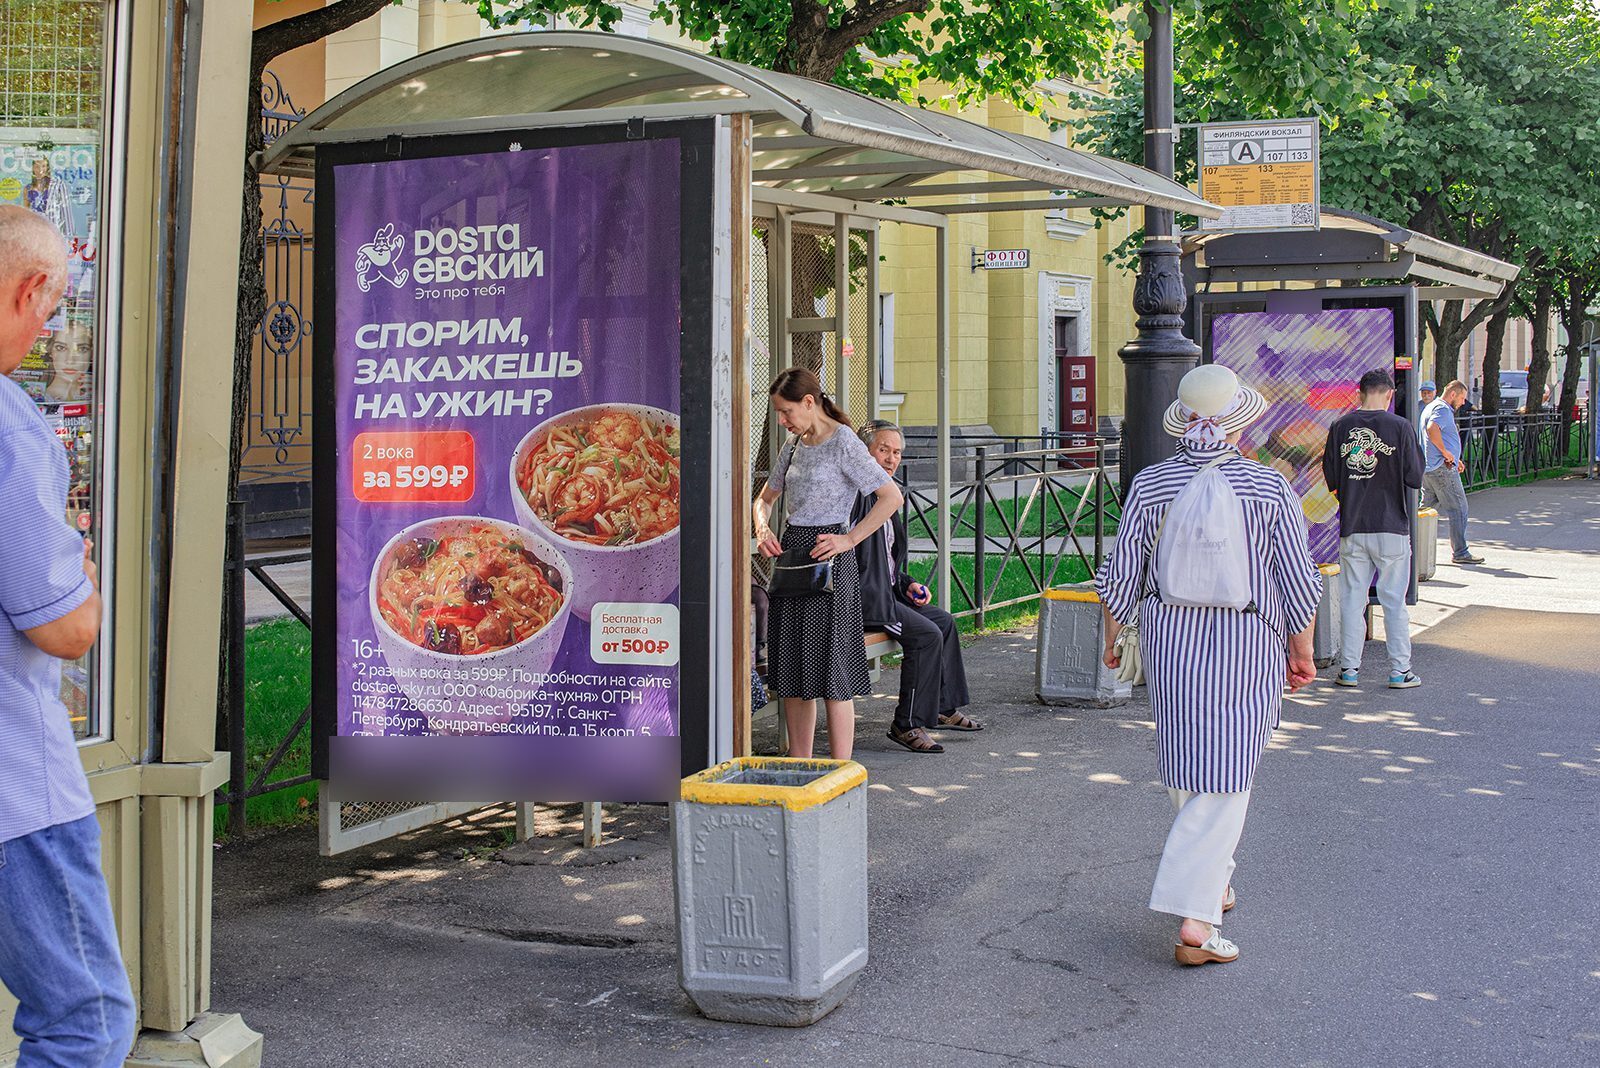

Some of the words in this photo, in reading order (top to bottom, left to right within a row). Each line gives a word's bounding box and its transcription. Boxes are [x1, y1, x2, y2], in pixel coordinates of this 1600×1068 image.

[1213, 129, 1270, 139] ФИНЛЯНДСКИЙ
[1271, 128, 1302, 137] ВОКЗАЛ
[1267, 152, 1284, 161] 107
[1291, 151, 1308, 160] 133
[54, 167, 93, 184] style
[1203, 167, 1218, 175] 107
[1258, 164, 1273, 173] 133
[987, 251, 1026, 261] ФОТО
[415, 288, 440, 300] Это
[443, 287, 470, 301] про
[472, 284, 506, 297] тебя
[354, 317, 529, 350] СПОРИМ,
[353, 351, 583, 385] ЗАКАЖЕШЬ
[354, 393, 407, 420] НА
[412, 388, 553, 418] УЖИН?
[363, 444, 373, 459] 2
[377, 447, 414, 459] вока
[362, 471, 391, 488] за
[395, 465, 469, 488] 599₽
[602, 613, 663, 624] Бесплатная
[601, 626, 648, 635] доставка
[351, 639, 384, 659] 16+
[601, 642, 620, 652] от
[621, 639, 670, 654] 500₽
[369, 666, 418, 679] разных
[420, 668, 451, 680] вока
[453, 670, 469, 680] за
[513, 669, 607, 687] Подробности
[609, 677, 627, 687] на
[628, 674, 672, 689] сайте
[352, 680, 441, 698] dostaevsky.ru
[443, 683, 477, 697] ООО
[601, 689, 643, 705] ОГРН
[351, 695, 455, 713] 1147847286630.
[457, 701, 504, 717] Адрес:
[507, 703, 554, 720] 195197,
[556, 708, 566, 719] г.
[352, 711, 426, 730] Петербург,
[427, 715, 540, 735] Кондратьевский
[582, 723, 597, 736] 15
